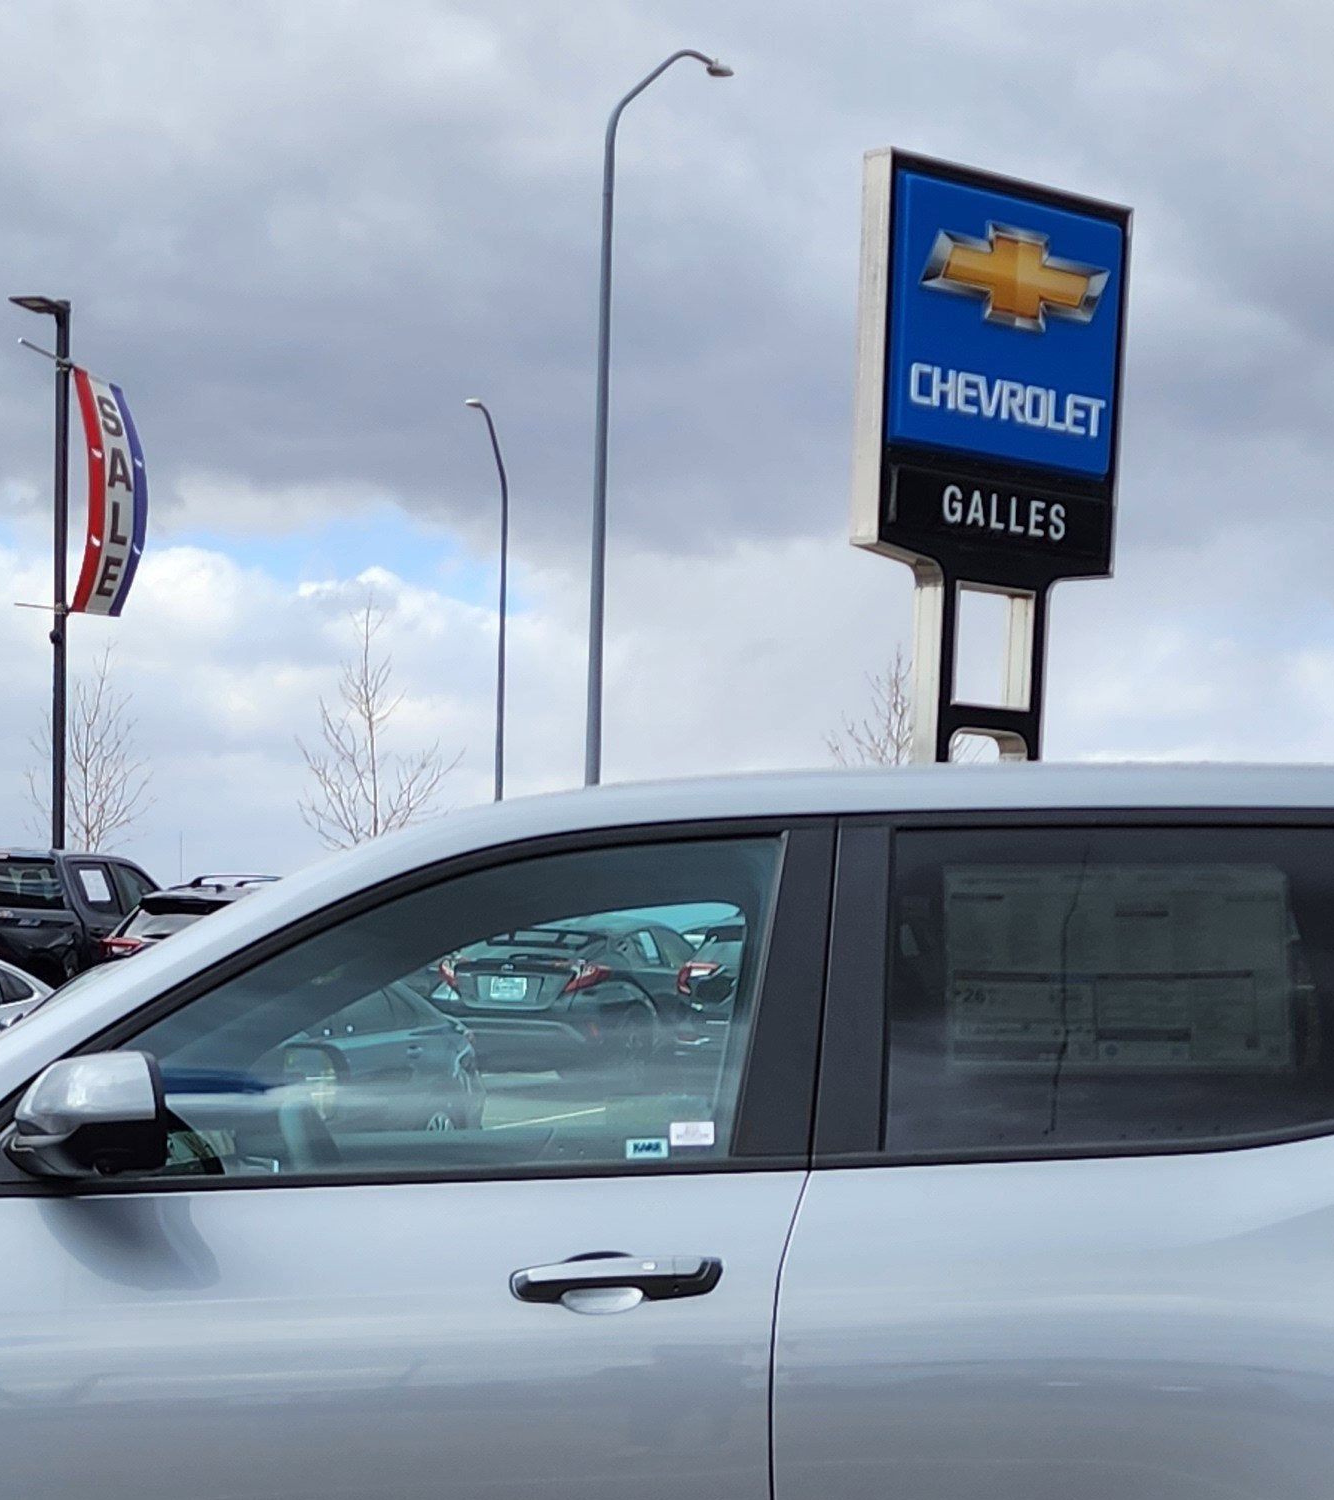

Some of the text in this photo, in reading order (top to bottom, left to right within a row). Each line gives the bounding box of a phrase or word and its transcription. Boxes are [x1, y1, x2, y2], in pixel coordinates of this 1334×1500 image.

[910, 362, 1106, 438] CHEVROLET
[96, 395, 133, 597] SALE
[942, 485, 1067, 541] GALLES
